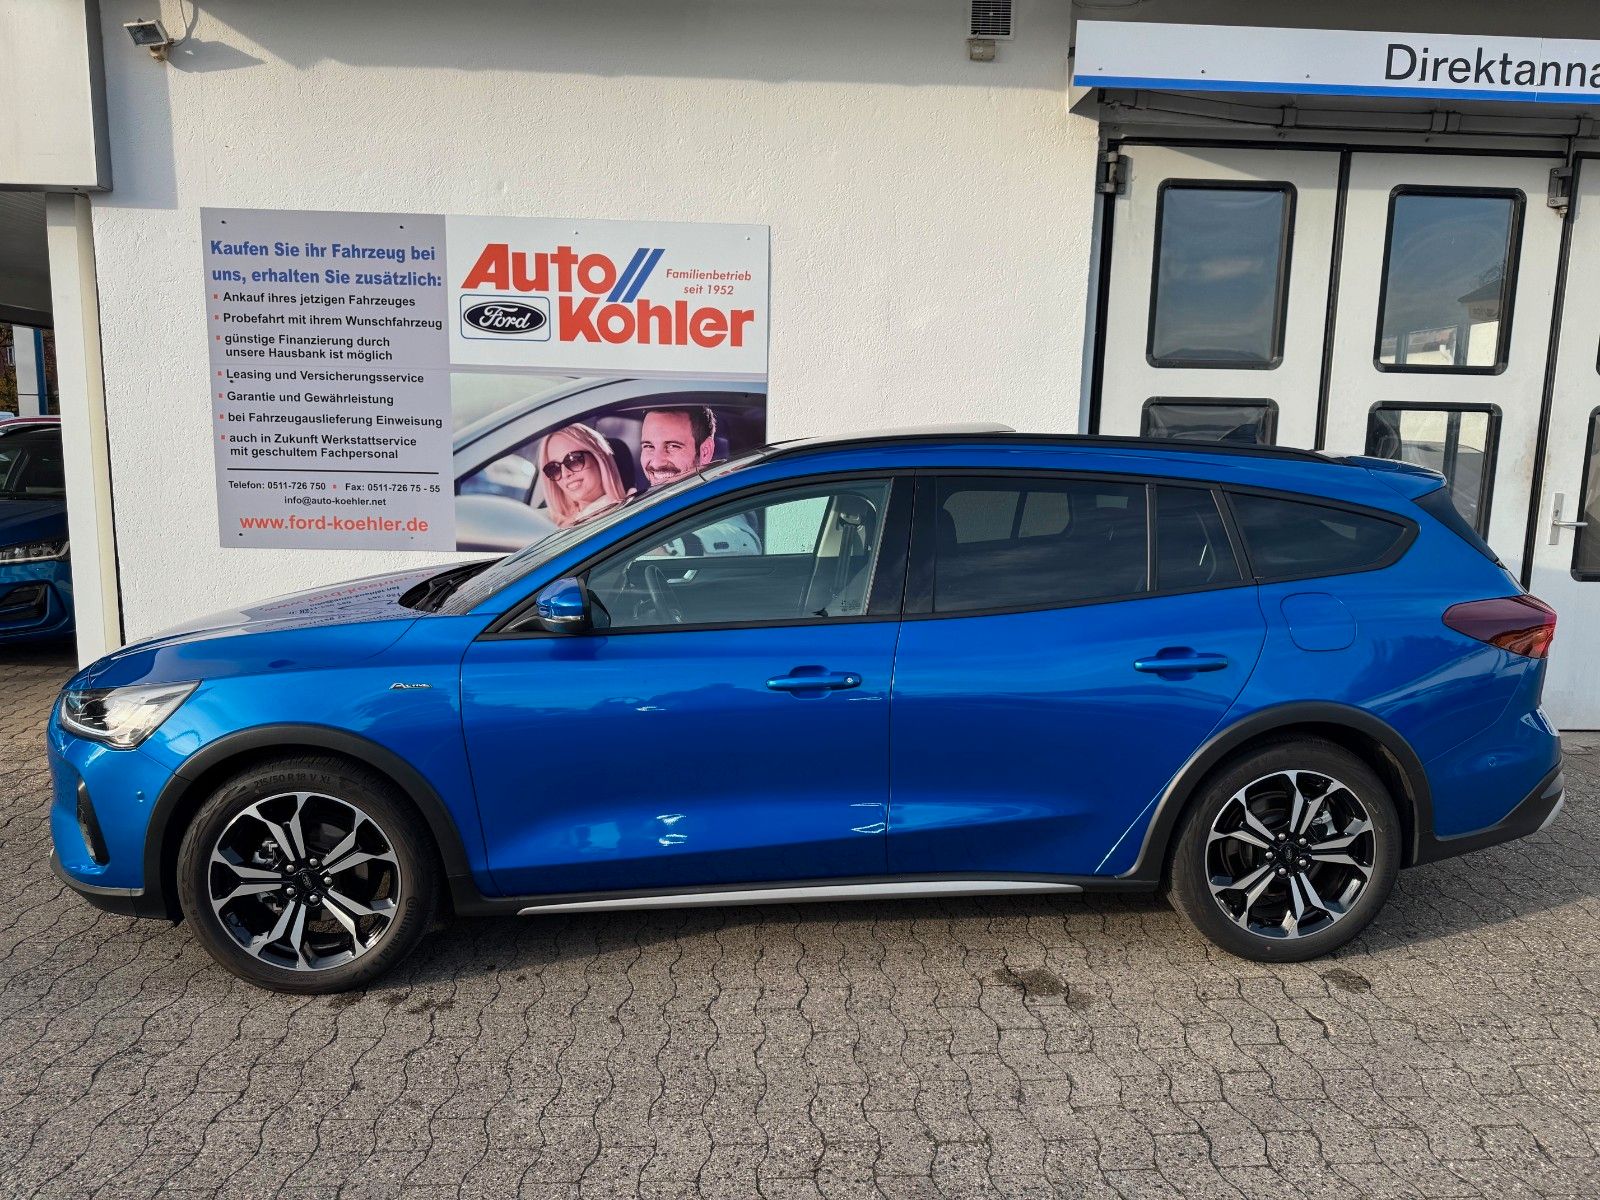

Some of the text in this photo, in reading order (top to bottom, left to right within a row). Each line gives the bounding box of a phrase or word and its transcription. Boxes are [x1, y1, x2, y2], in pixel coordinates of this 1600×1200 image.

[211, 241, 435, 263] Kaufen Sie ihr Fahrzeug bei
[461, 243, 616, 294] Auto
[666, 269, 751, 281] Familienbetrieb
[213, 269, 442, 286] uns, erhalten Sie zusätzlich:
[684, 285, 734, 295] seit 1952
[223, 292, 415, 307] Ankauf ihres jetzigen Fahrzeuges
[224, 313, 443, 329] Probefahrt mit ihrem Wunschfahrzeug
[479, 305, 531, 329] Ford
[225, 335, 390, 347] günstige Finanzierung durch
[226, 348, 392, 361] unsere Hausbank ist möglich
[226, 369, 424, 384] Leasing und Versicherungsservice
[227, 392, 394, 406] Garantie und Gewährleistung
[228, 413, 443, 428] bei Fahrzeugauslieferung Einweisung
[230, 434, 417, 446] auch in Zukunft Werkstattservice
[230, 447, 398, 461] mit geschultem Fachpersonal
[229, 481, 265, 489] Telefon:
[267, 482, 307, 490] 0511-726
[368, 484, 408, 492] 0511-726
[285, 497, 386, 506] info@auto-koehler.net
[240, 515, 429, 532] www.ford-koehler.de
